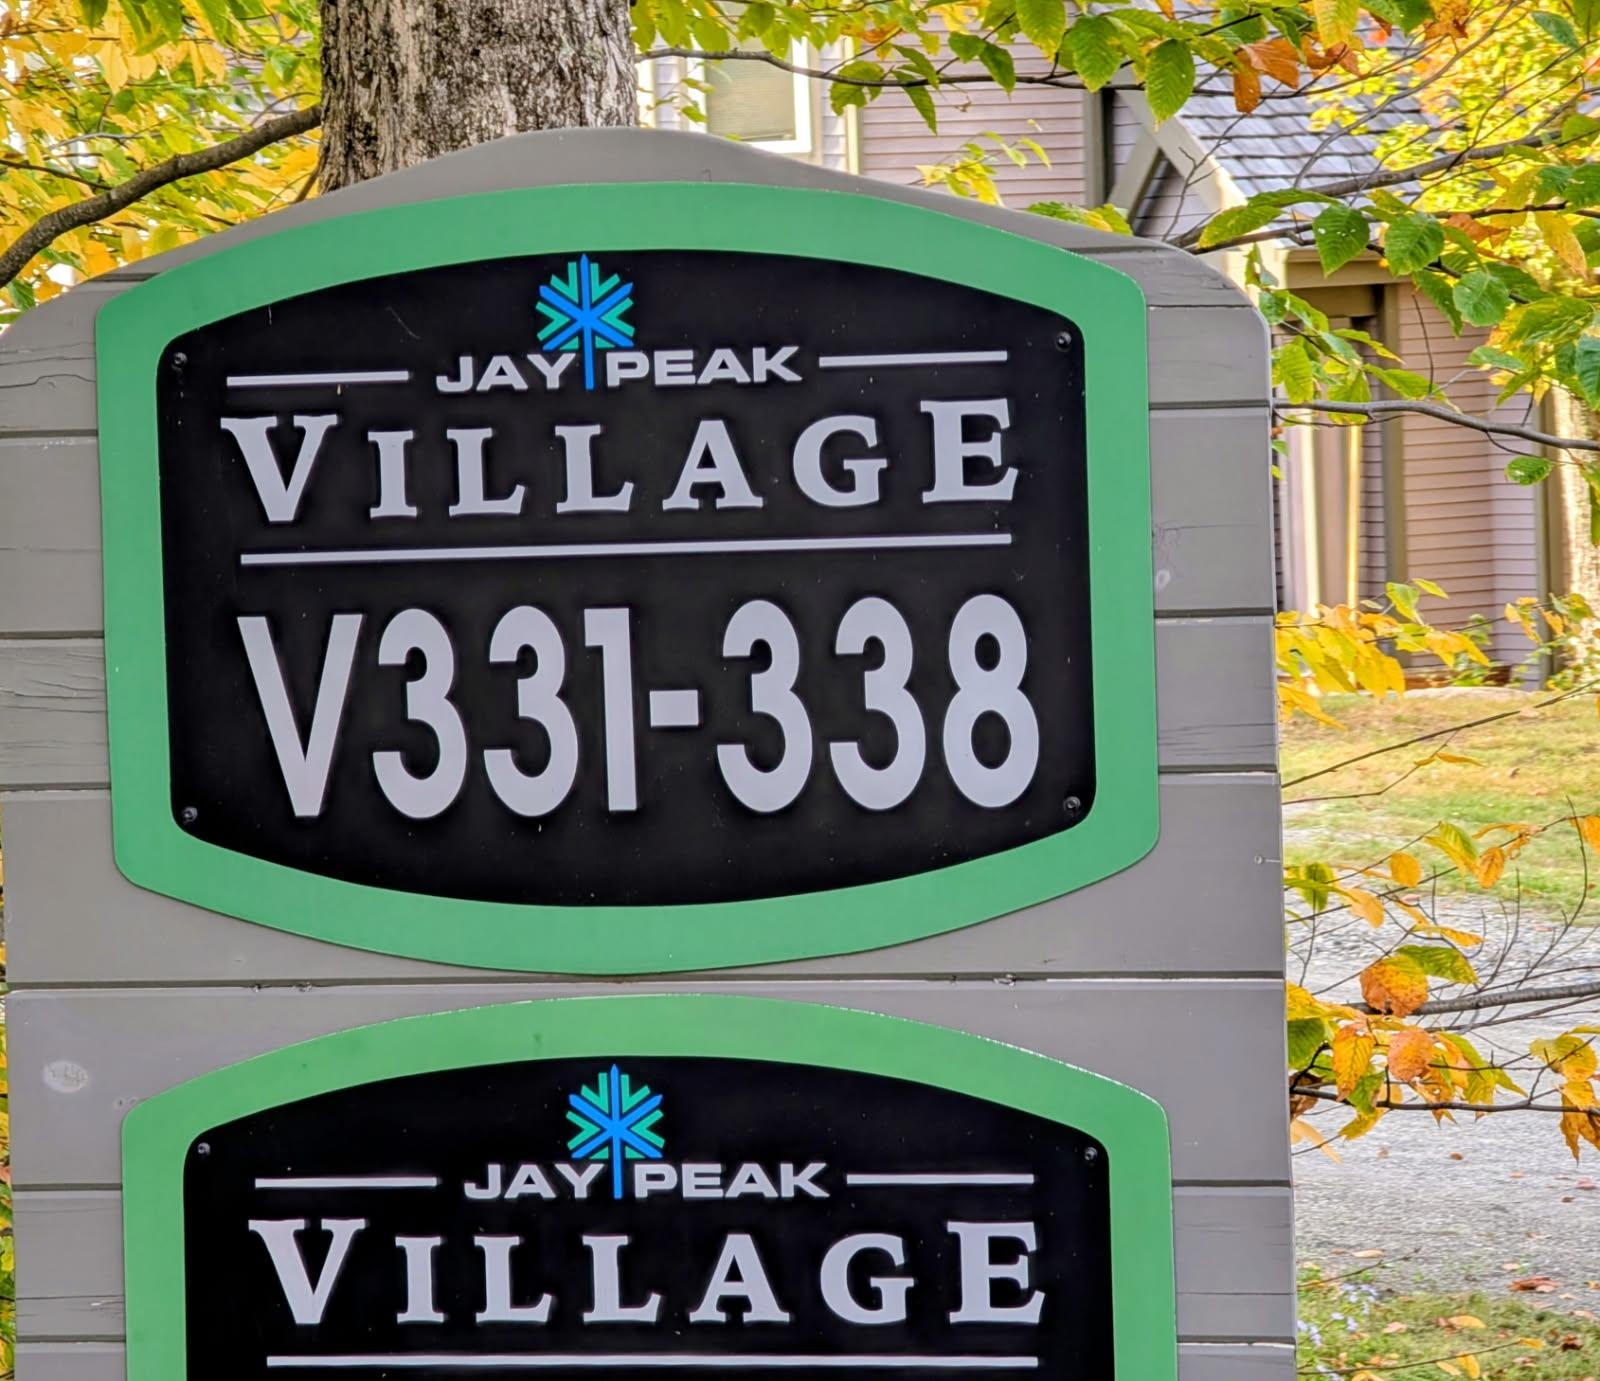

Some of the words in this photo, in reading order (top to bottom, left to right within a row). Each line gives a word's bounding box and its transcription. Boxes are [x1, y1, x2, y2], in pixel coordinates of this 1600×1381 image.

[436, 352, 576, 393] JAY
[606, 345, 803, 388] PEAK
[220, 398, 1019, 522] VILLAGE
[236, 594, 1040, 819] V331-338
[464, 1163, 606, 1200] JAY
[633, 1162, 830, 1199] PEAK
[248, 1218, 1046, 1326] VILLAGE
